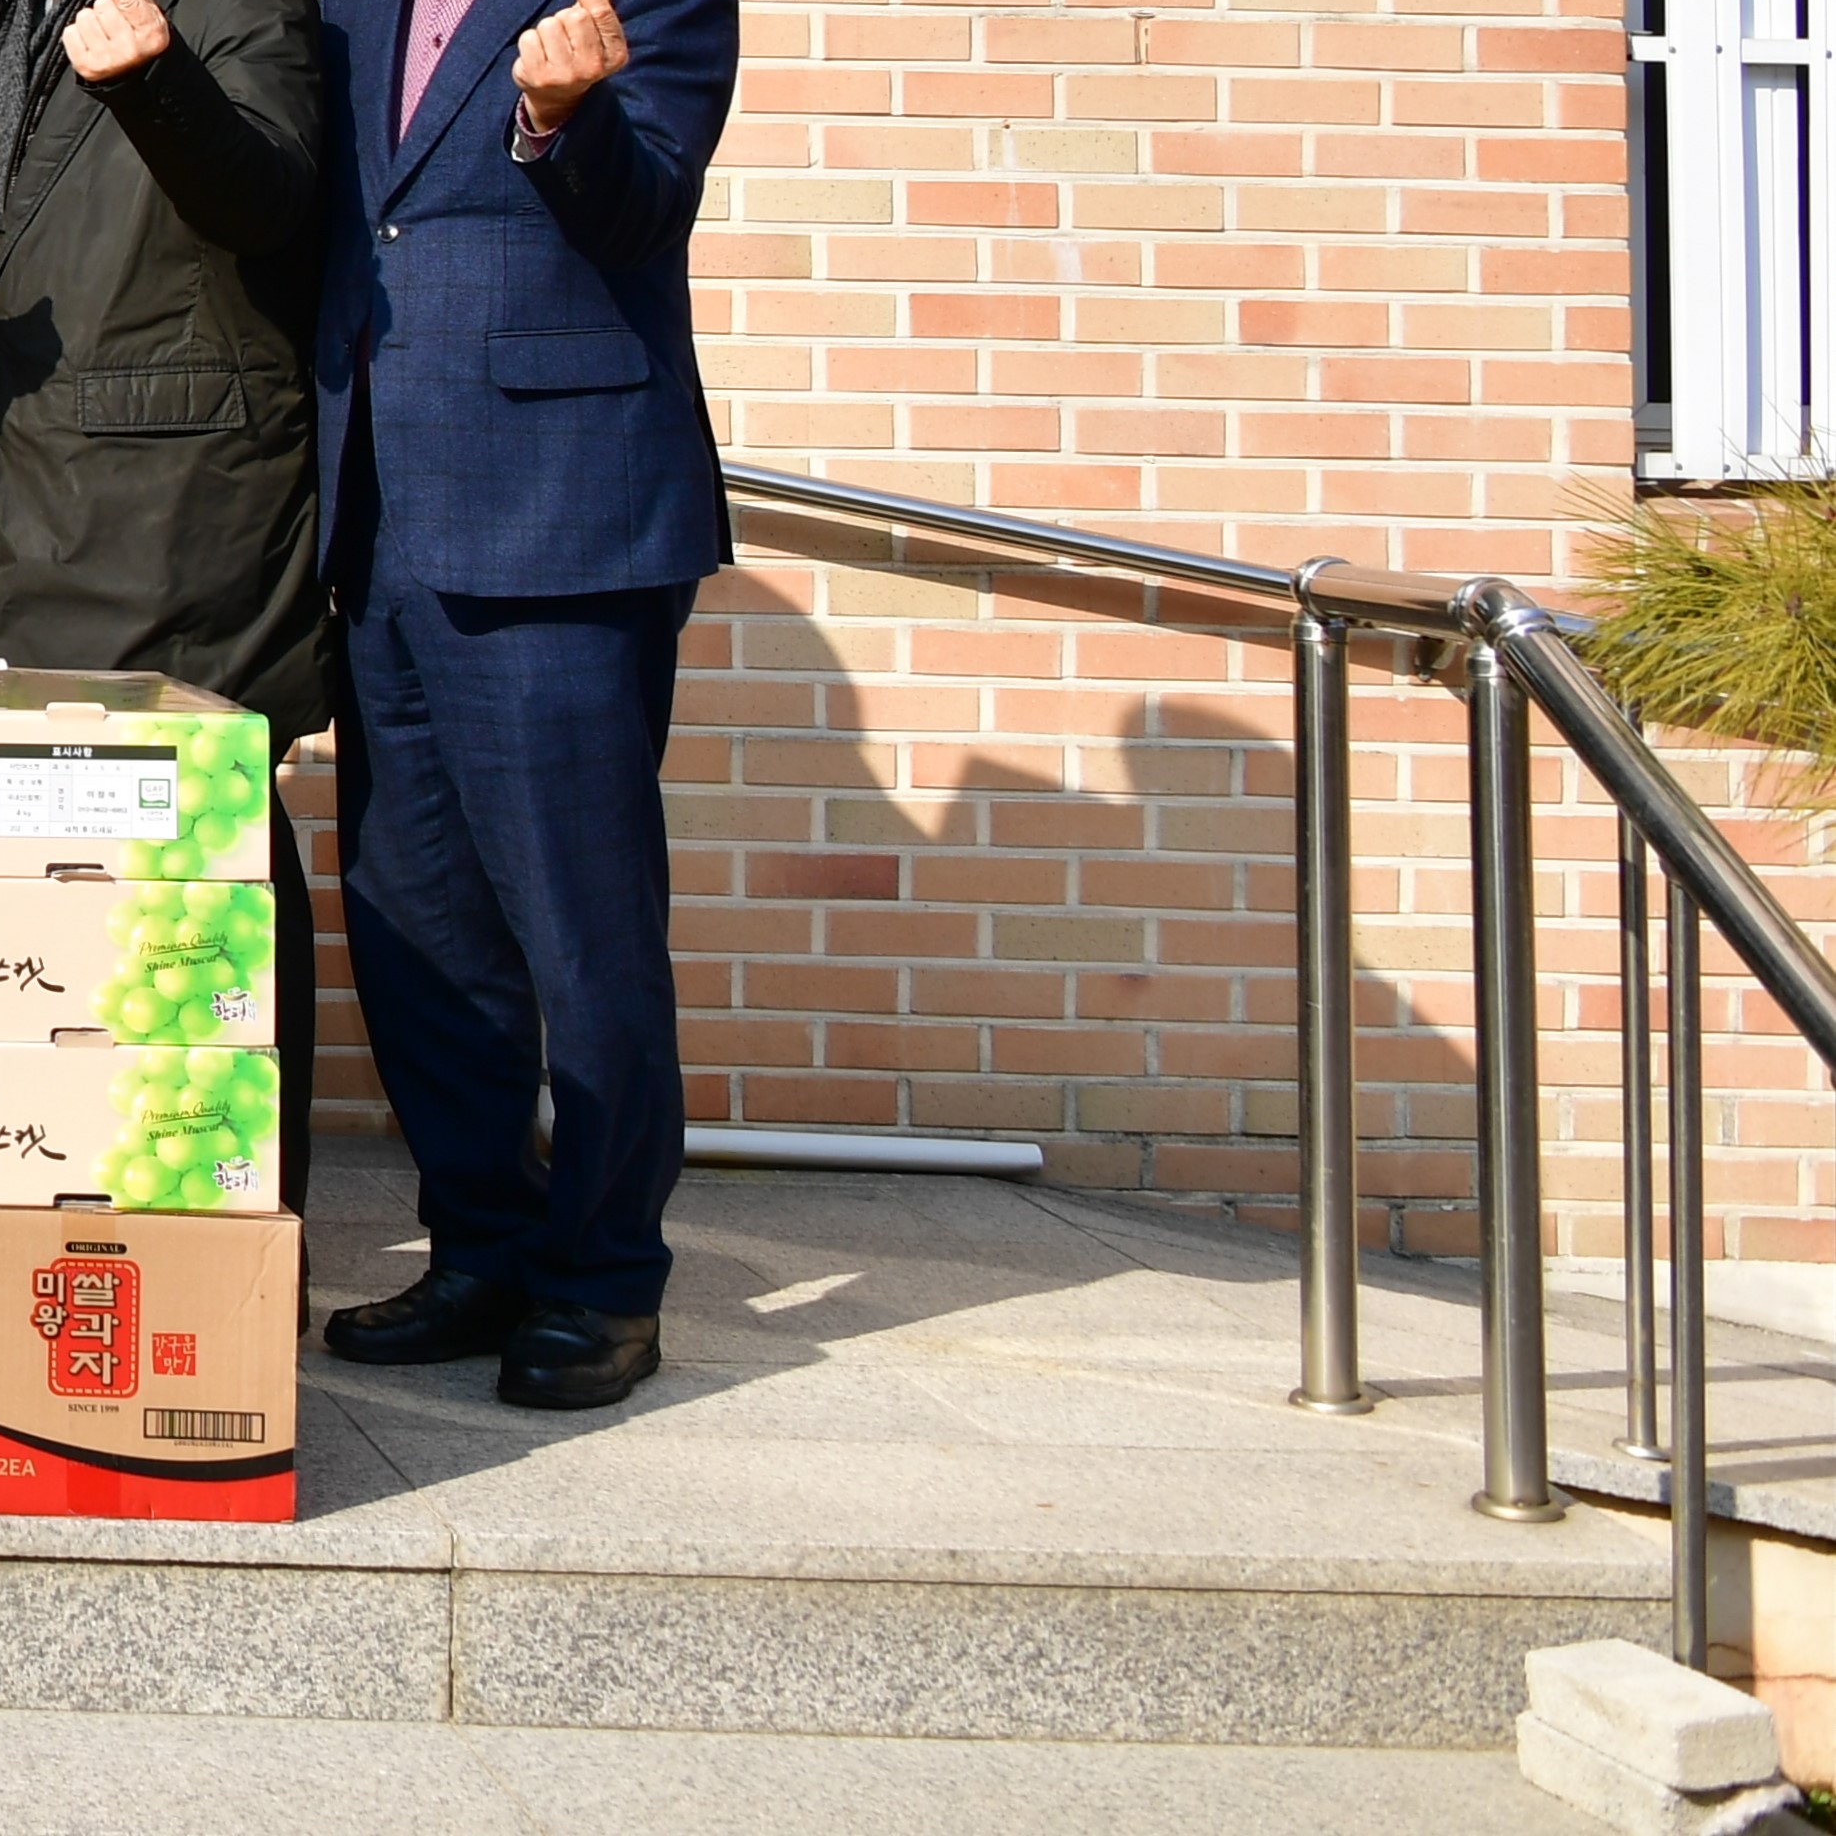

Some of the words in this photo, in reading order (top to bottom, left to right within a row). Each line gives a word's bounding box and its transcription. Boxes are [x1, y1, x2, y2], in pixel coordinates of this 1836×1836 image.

[52, 746, 93, 757] 표시사항
[138, 940, 188, 956] Premium
[190, 931, 229, 948] Quality
[144, 959, 176, 974] Shine
[141, 1108, 191, 1124] Premium
[192, 1100, 231, 1116] Quality
[146, 1127, 178, 1141] Shine
[71, 1243, 122, 1253] ORIGINAL
[35, 1269, 69, 1338] 미왕
[70, 1271, 121, 1386] 쌀과자
[153, 1335, 196, 1356] 갓구운
[67, 1403, 98, 1413] SINCE
